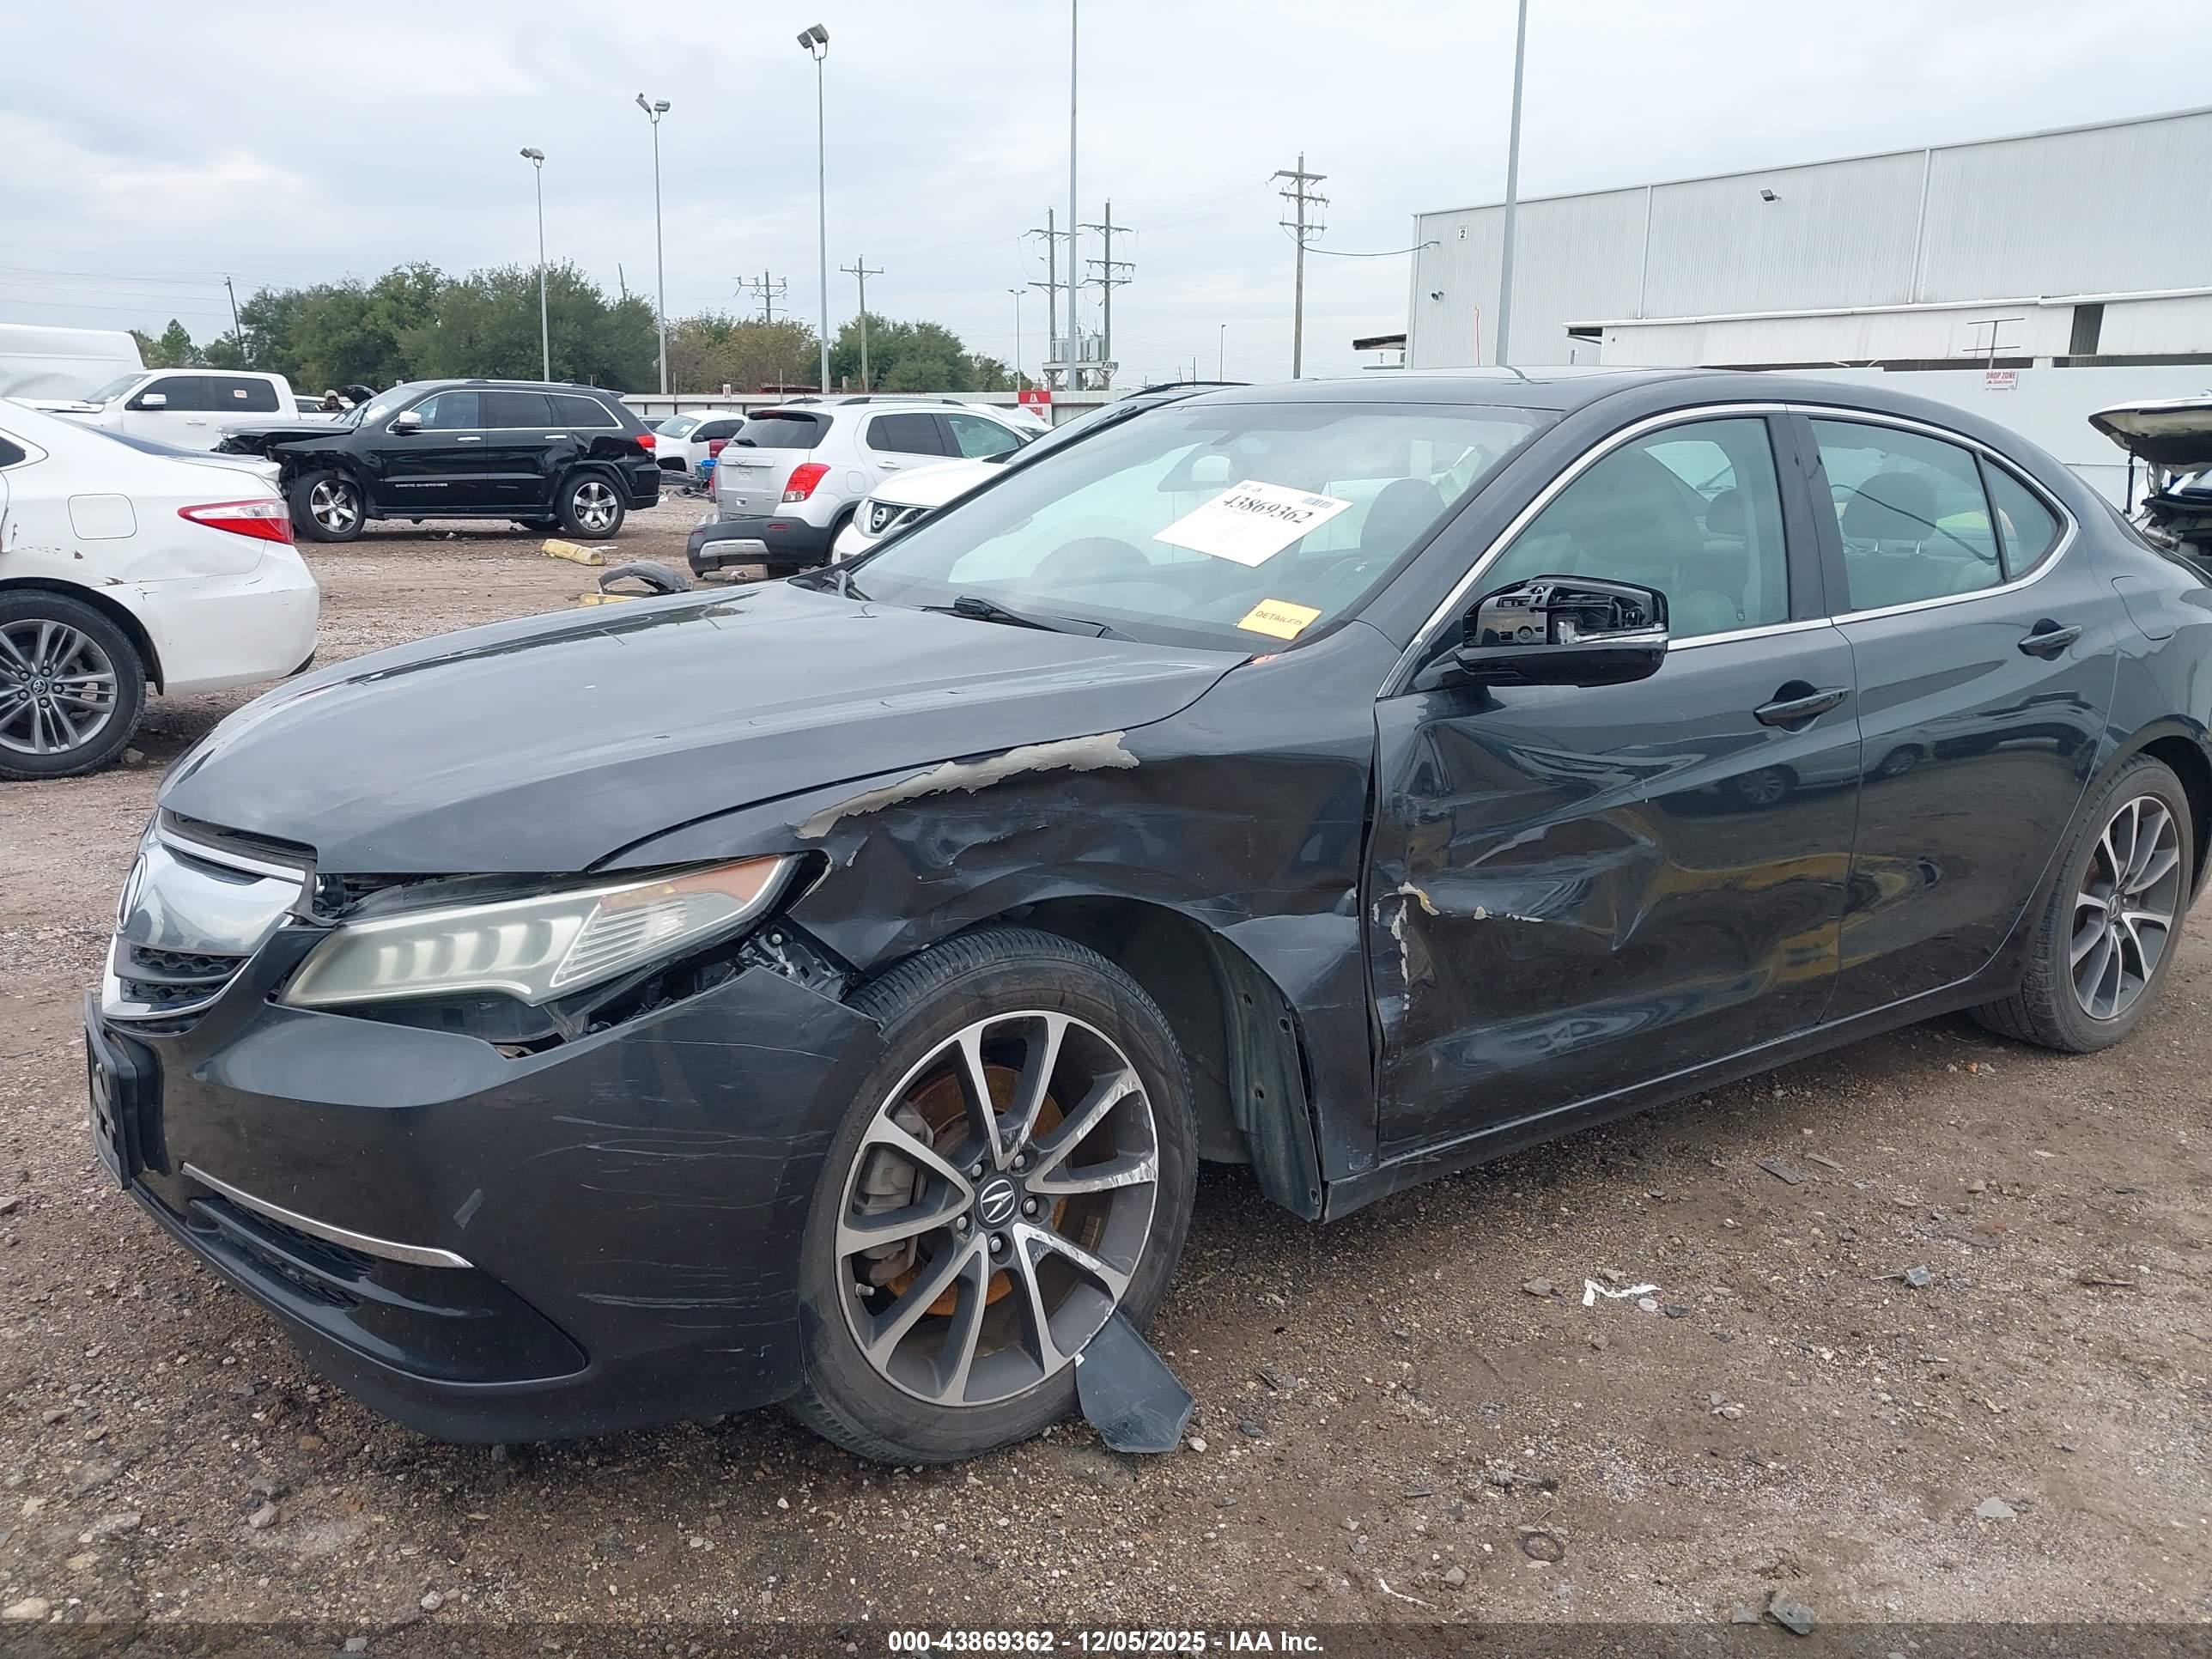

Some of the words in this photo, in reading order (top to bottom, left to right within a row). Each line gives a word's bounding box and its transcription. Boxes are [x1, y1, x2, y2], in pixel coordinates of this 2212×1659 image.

[1460, 229, 1466, 239] 2
[1985, 371, 2002, 380] DROP
[1223, 495, 1314, 524] 43869362
